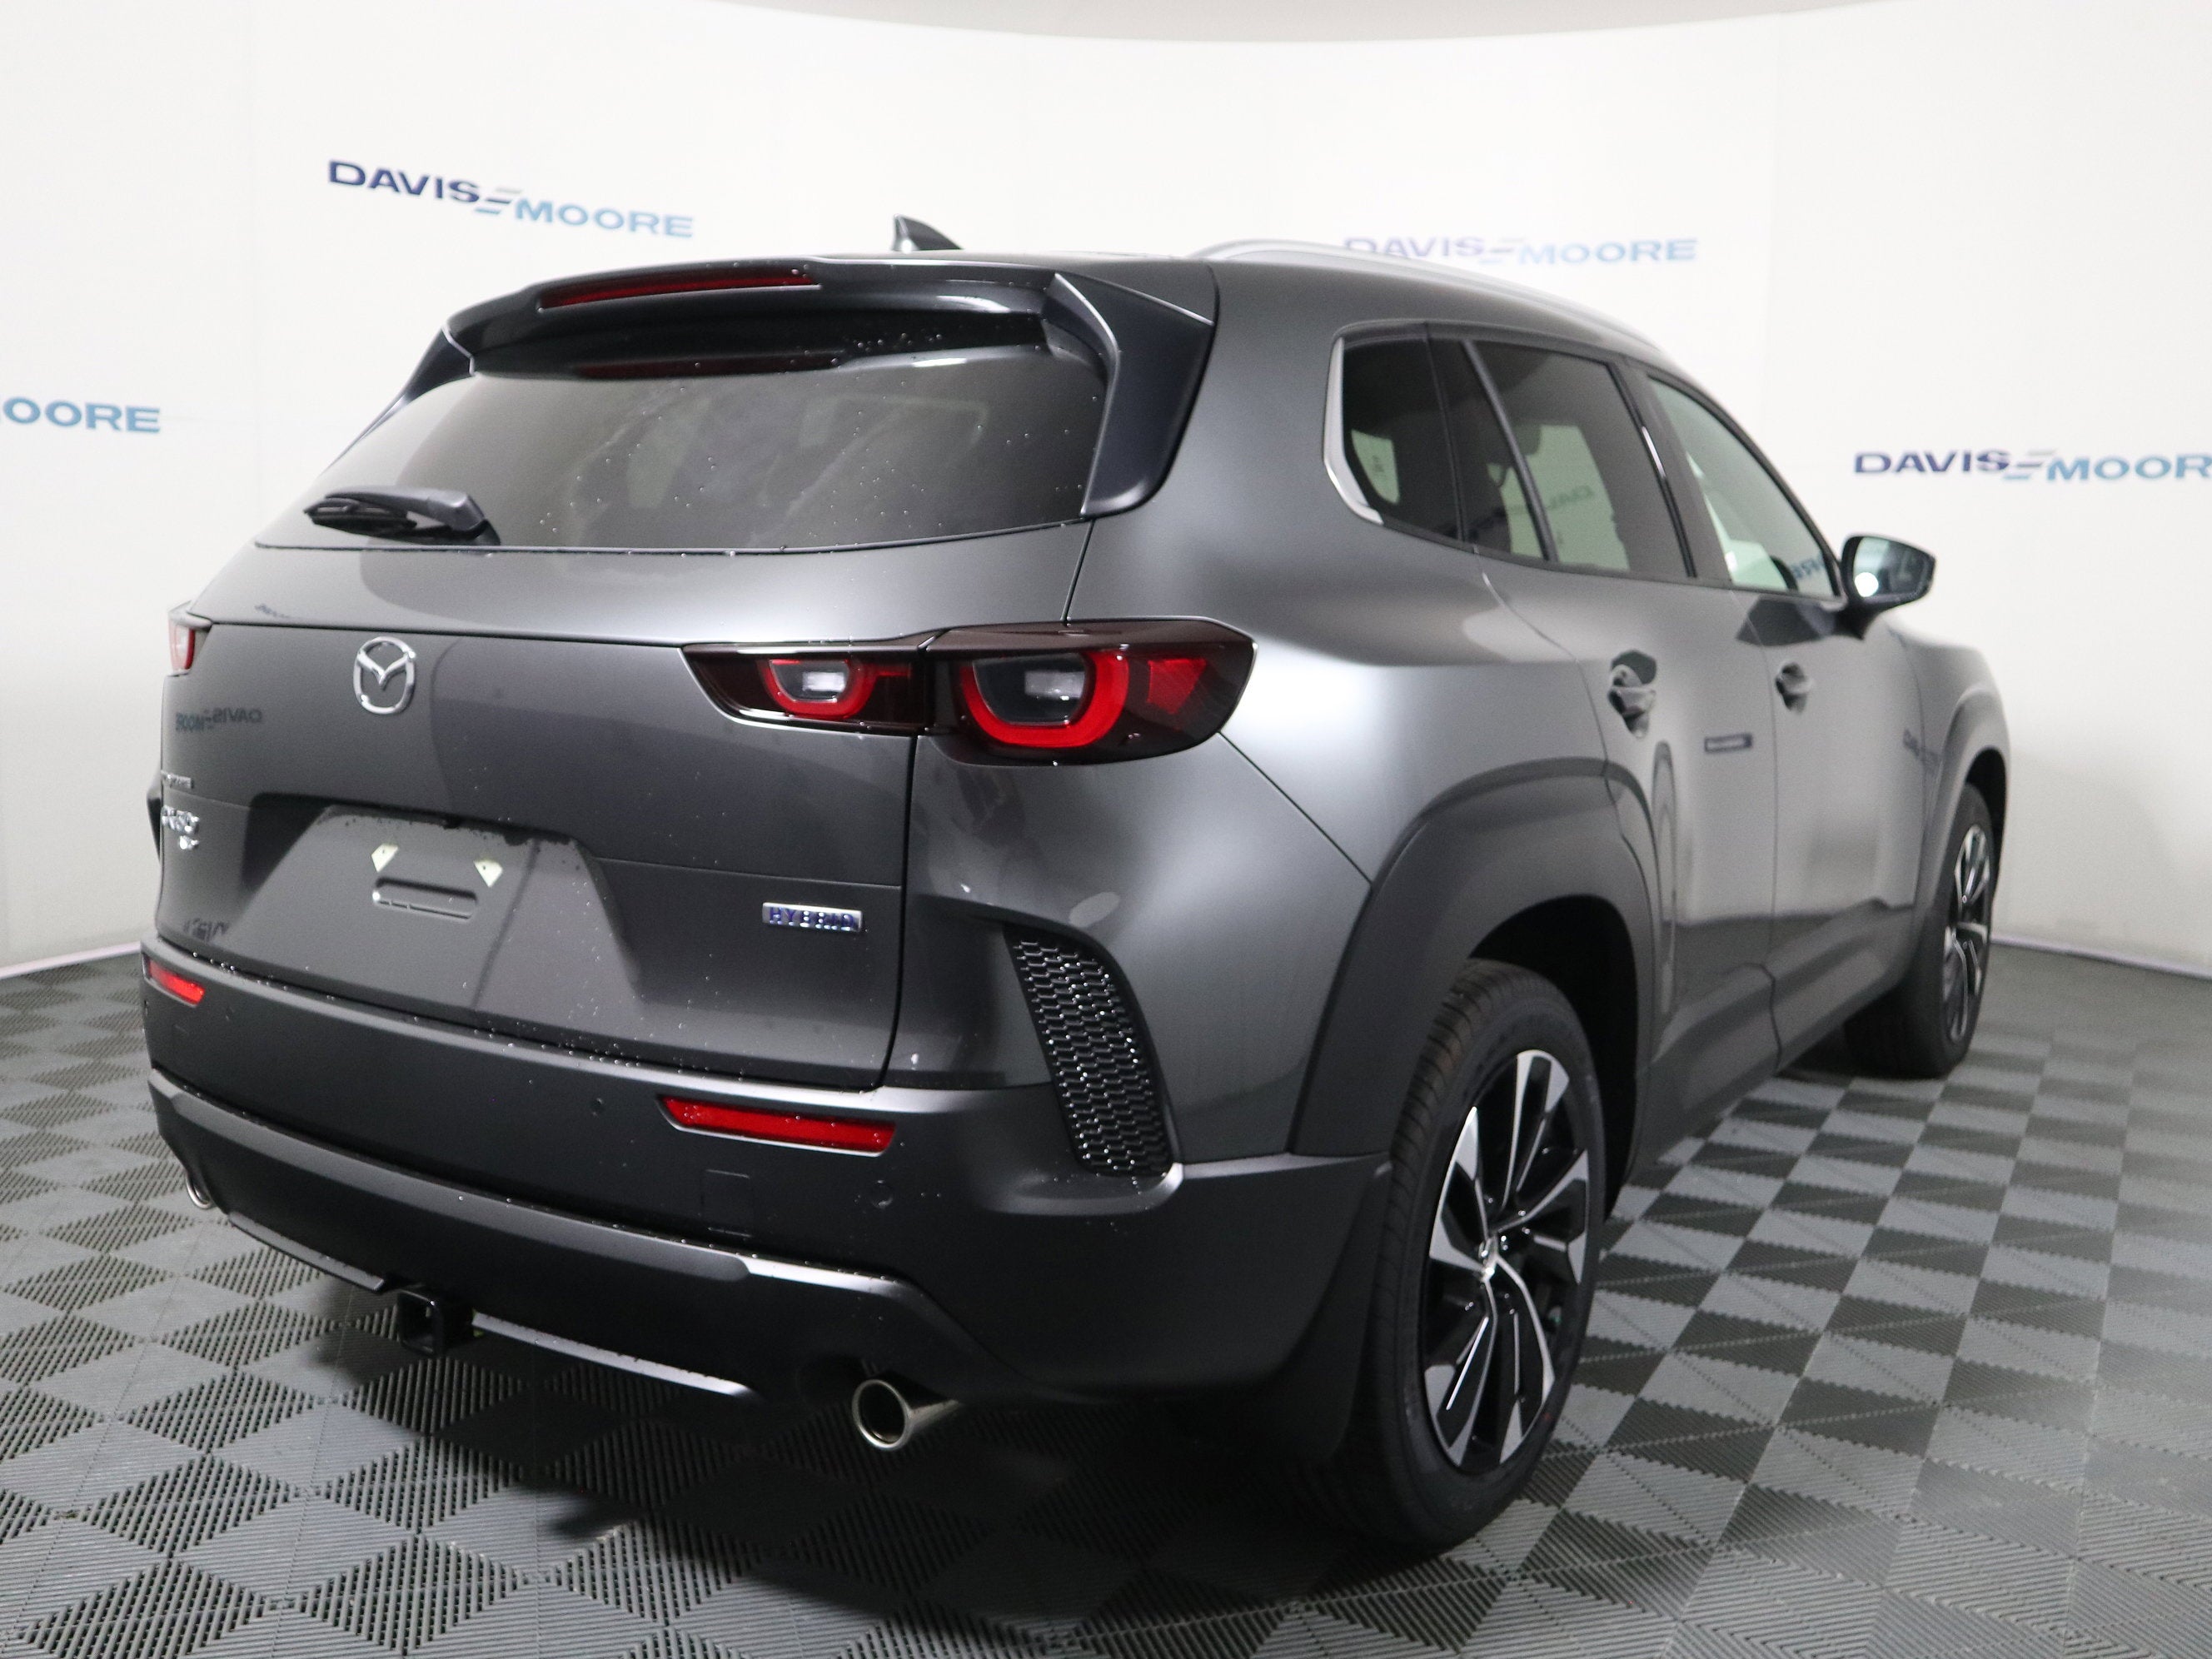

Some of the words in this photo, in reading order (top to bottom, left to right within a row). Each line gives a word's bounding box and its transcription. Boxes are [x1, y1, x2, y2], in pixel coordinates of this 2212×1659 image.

[329, 161, 480, 203] DAVIS
[2, 396, 161, 433] OORE
[1854, 450, 2011, 474] DAVIS
[769, 907, 854, 931] HYBRID
